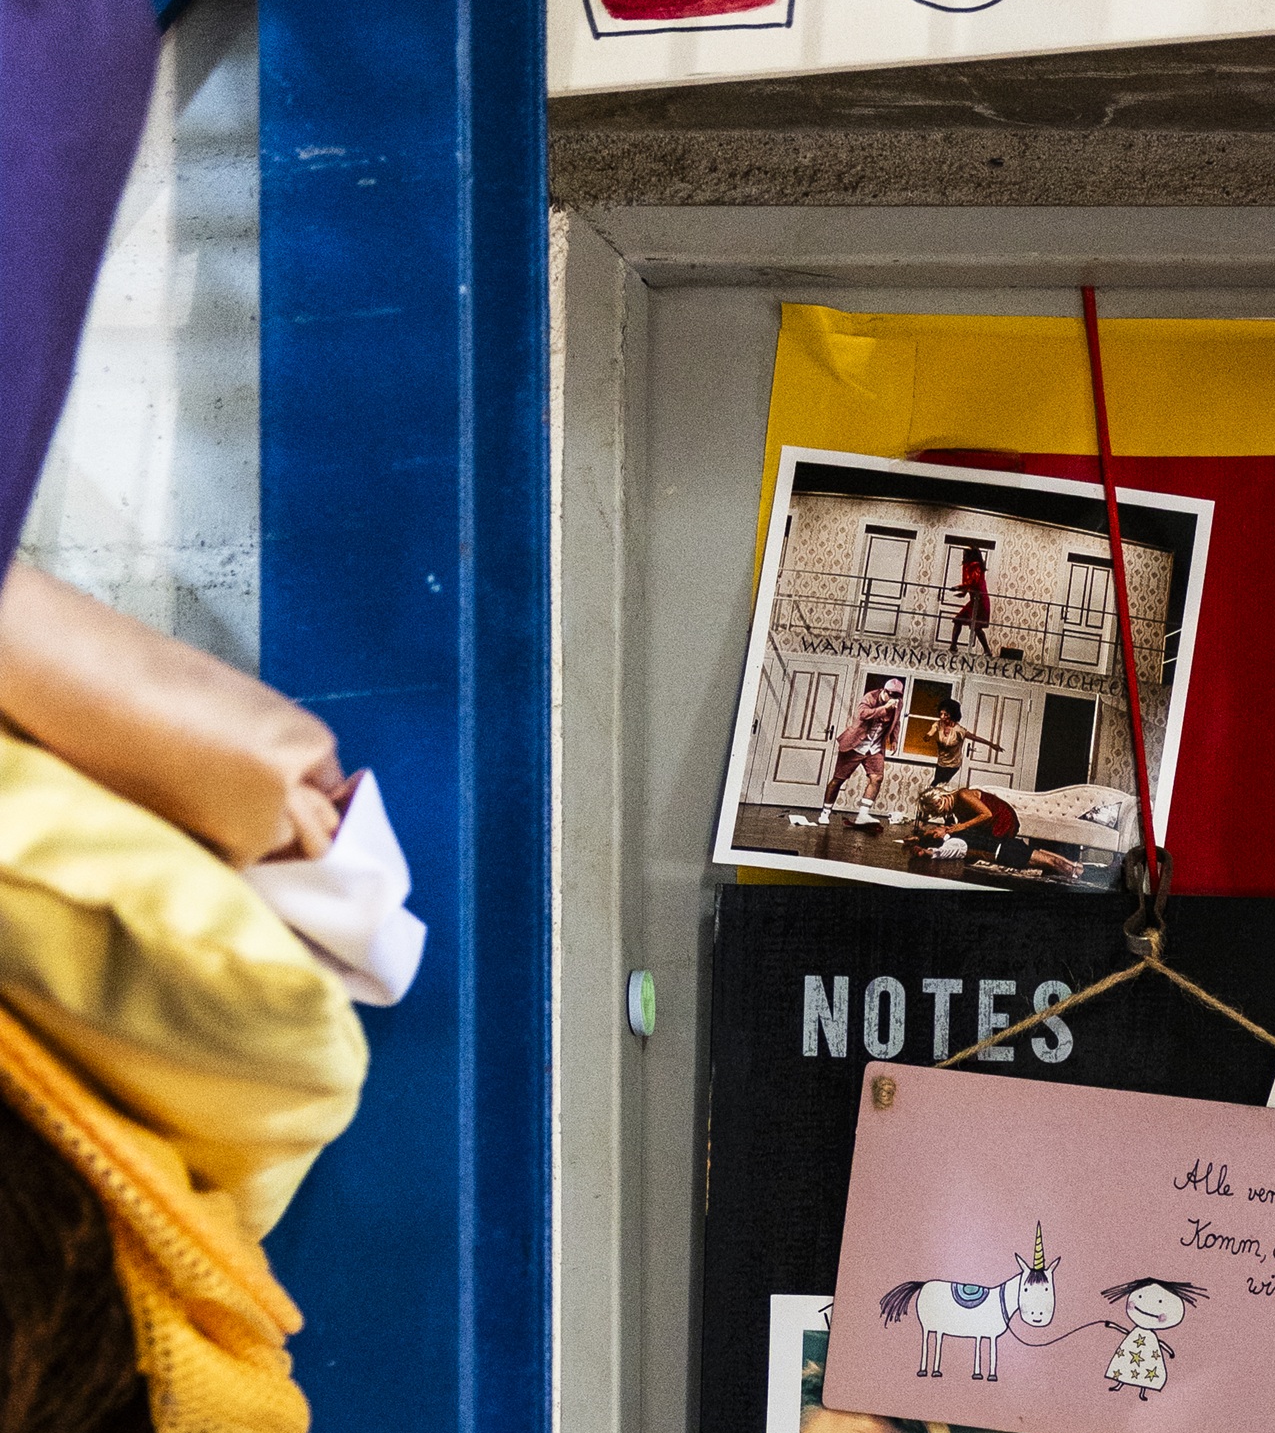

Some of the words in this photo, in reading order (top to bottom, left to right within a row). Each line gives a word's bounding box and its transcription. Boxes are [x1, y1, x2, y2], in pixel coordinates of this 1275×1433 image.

[802, 975, 1074, 1062] NOTES
[1172, 1156, 1237, 1198] Alle
[1178, 1217, 1270, 1263] Komm,
